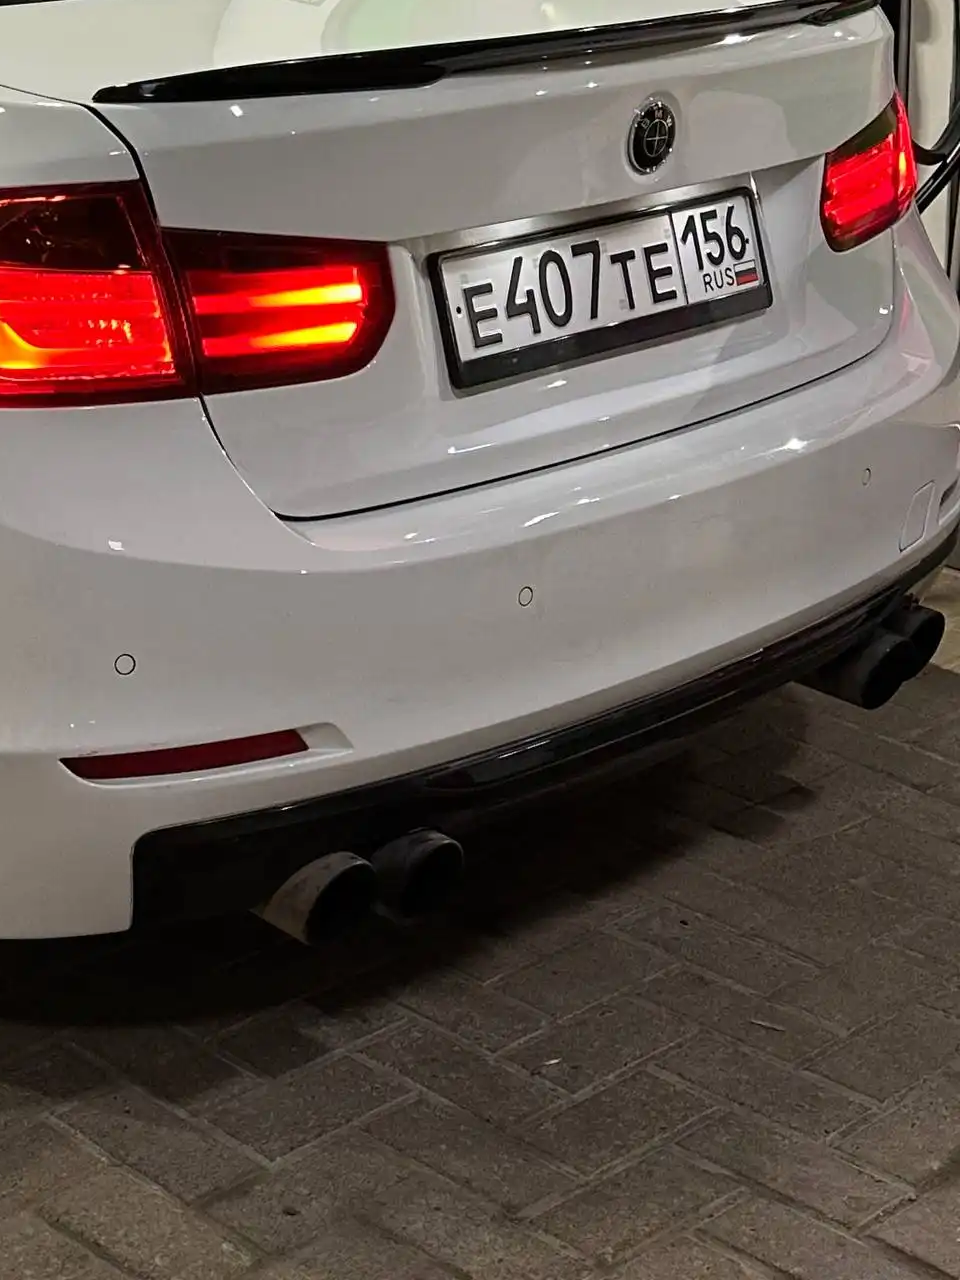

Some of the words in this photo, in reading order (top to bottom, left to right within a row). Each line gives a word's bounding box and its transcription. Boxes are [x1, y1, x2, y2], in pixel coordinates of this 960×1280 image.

[462, 240, 678, 349] Е407ТЕ
[681, 205, 747, 271] 156
[703, 271, 735, 293] RUS
